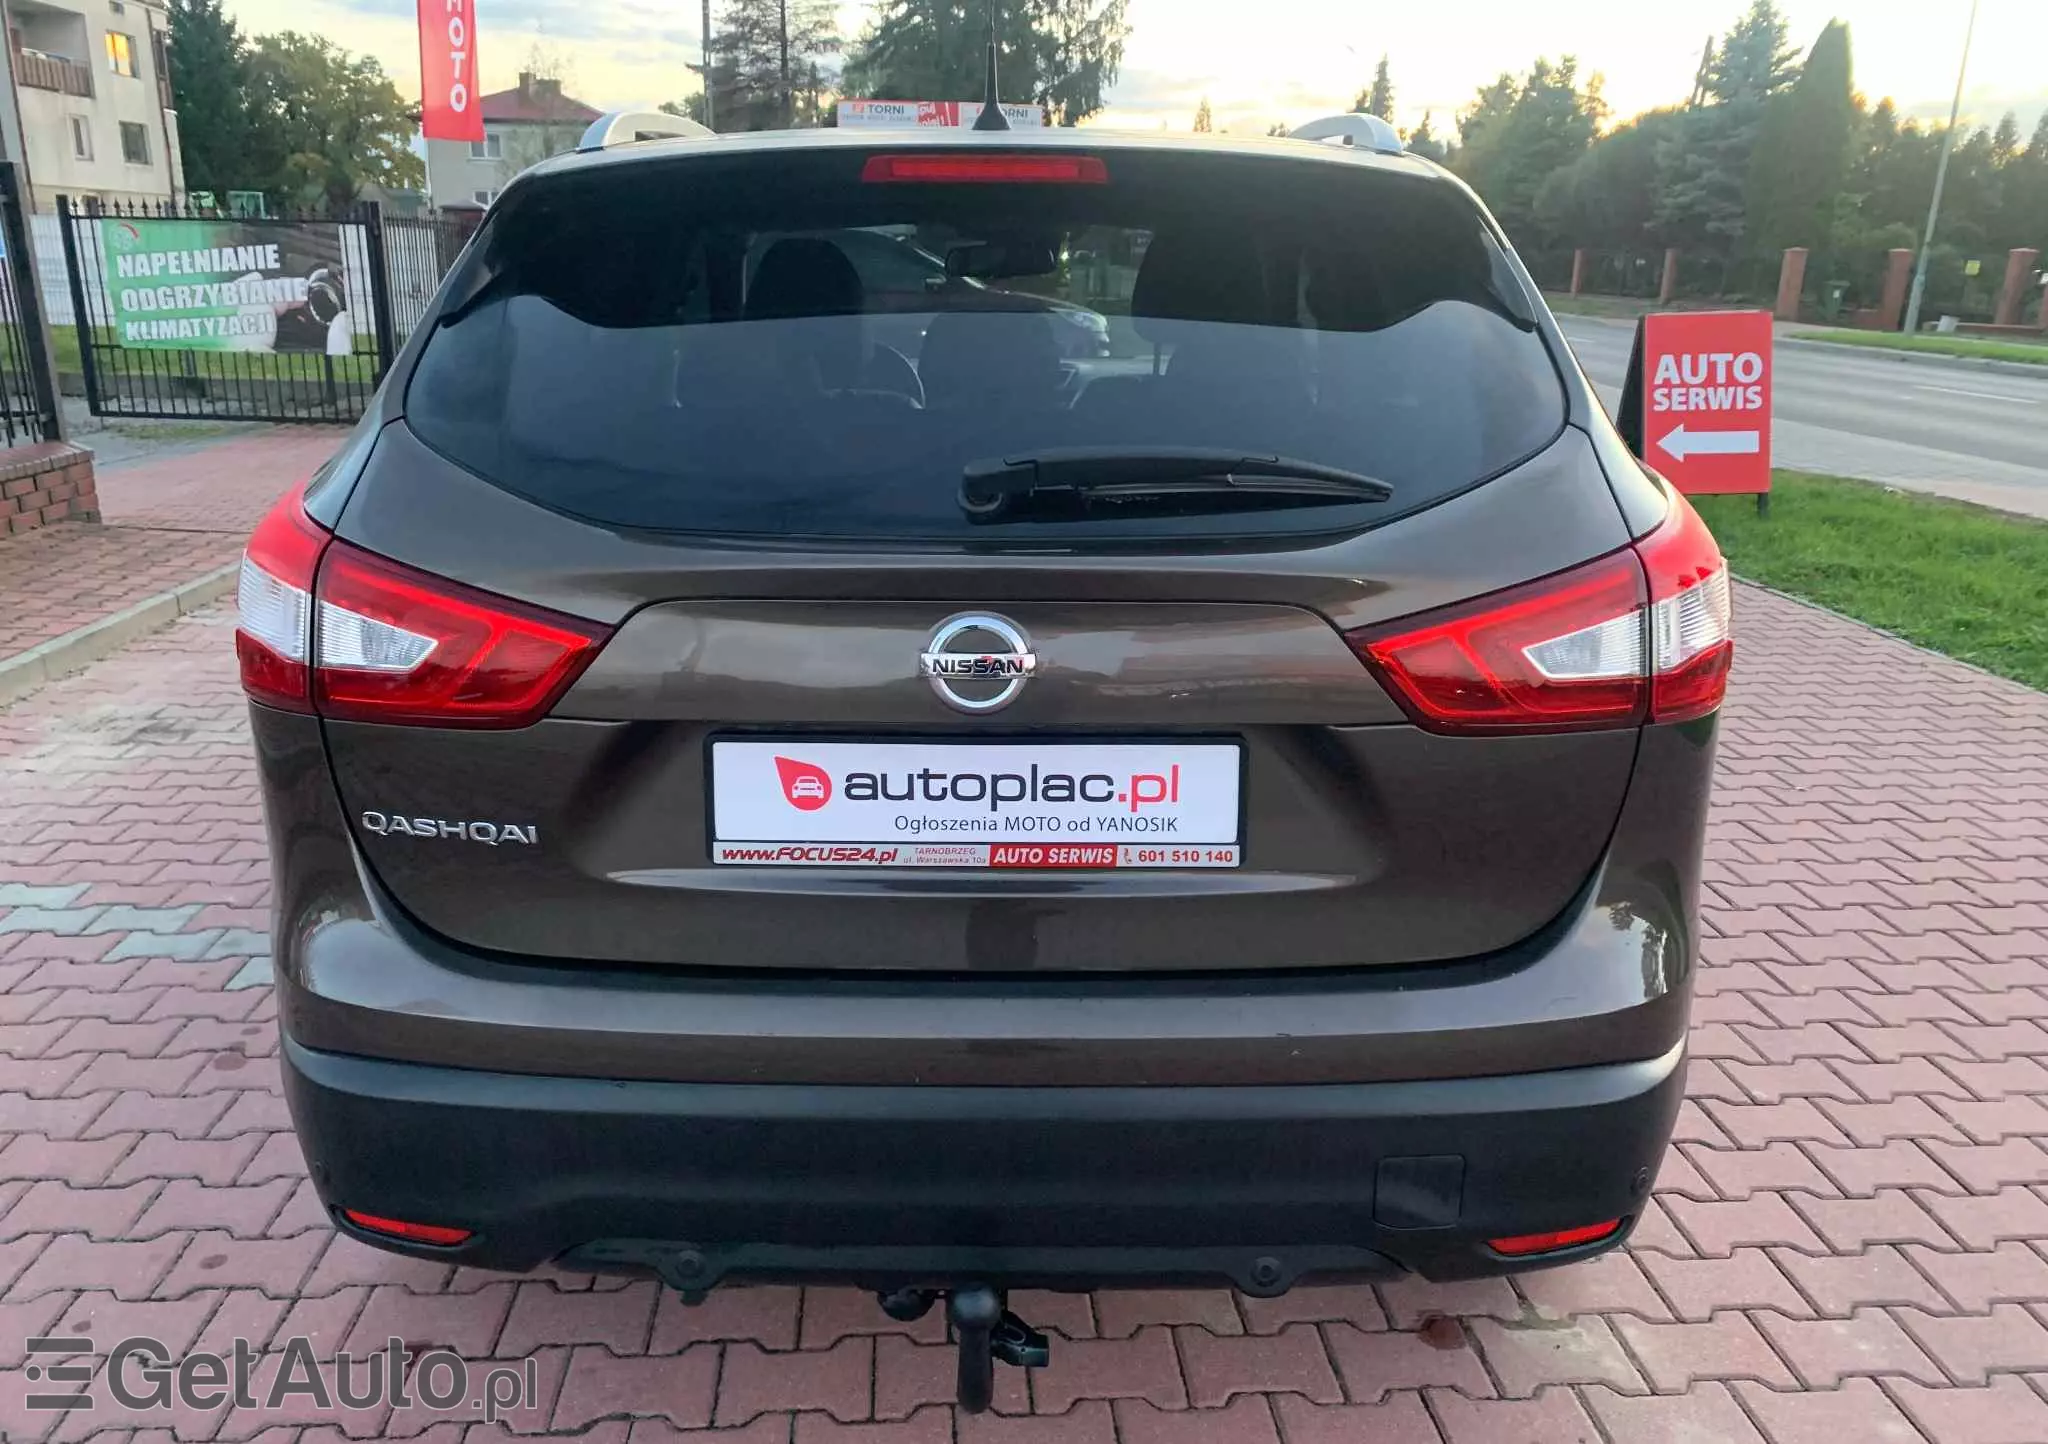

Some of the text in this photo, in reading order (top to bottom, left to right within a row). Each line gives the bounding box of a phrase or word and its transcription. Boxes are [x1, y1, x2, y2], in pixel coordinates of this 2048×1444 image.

[868, 104, 904, 114] TORNI
[116, 244, 280, 278] NAPEŁNIANIE
[121, 277, 308, 312] ODGRZYBIANIE
[125, 312, 277, 341] KLIMATYZACJI
[1653, 352, 1763, 385] AUTO
[1653, 386, 1763, 411] SERWIS
[932, 658, 1023, 673] NISSAN
[844, 764, 1180, 812] autoplac.pl
[362, 811, 537, 846] QASHQAI
[895, 815, 1177, 834] Ogłoszenia MOTO od YANOSIK
[722, 847, 898, 864] www.FOCUS24.pl
[915, 847, 977, 855] TARNOBRZEG
[993, 848, 1113, 864] AUTO SERWIS
[1138, 850, 1232, 862] 601 510 140
